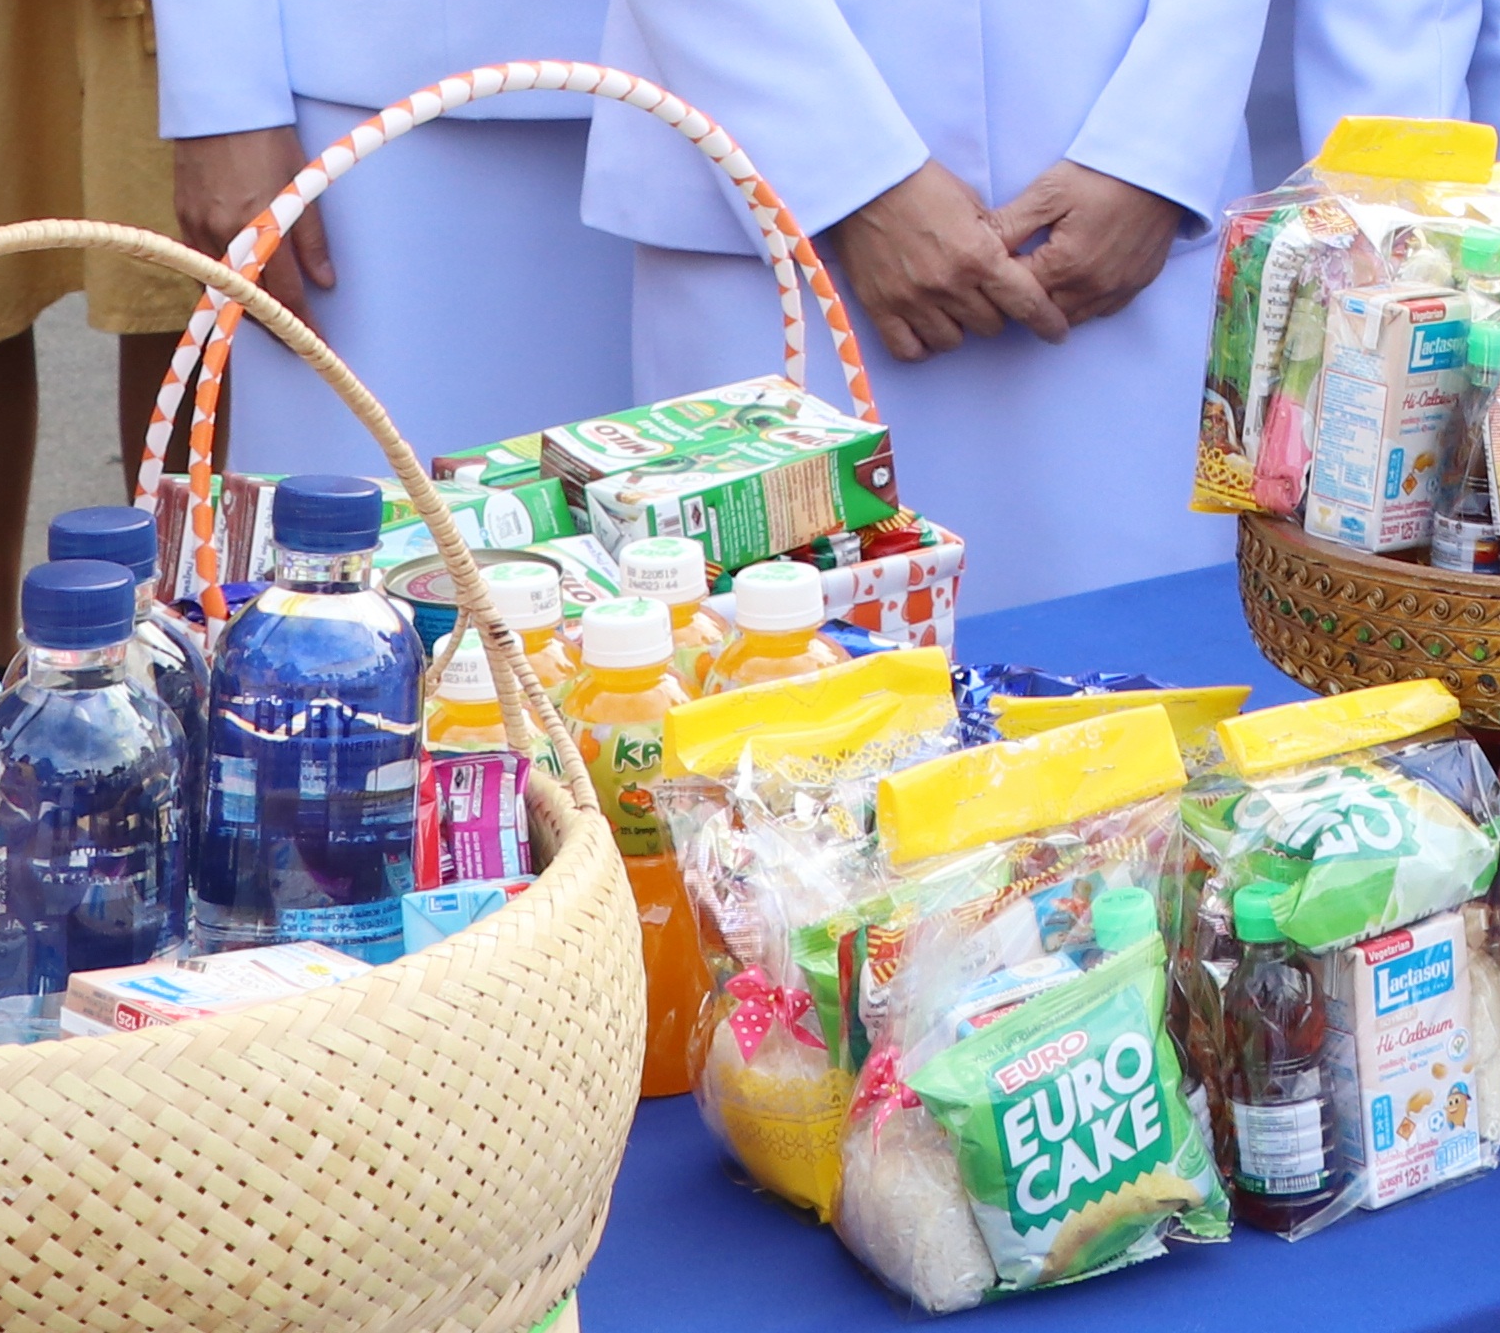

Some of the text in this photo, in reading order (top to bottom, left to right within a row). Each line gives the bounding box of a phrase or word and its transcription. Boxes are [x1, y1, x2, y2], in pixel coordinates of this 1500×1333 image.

[594, 424, 656, 454] MILO
[1367, 939, 1411, 962] Vegetarian
[1377, 959, 1451, 1010] Lactasoy
[117, 1010, 138, 1031] 125
[1376, 1018, 1455, 1056] Hi-Calcium
[994, 1030, 1088, 1094] EURO
[1002, 1031, 1153, 1169] EURO
[1016, 1083, 1162, 1215] CAKE
[1404, 1165, 1422, 1188] 125
